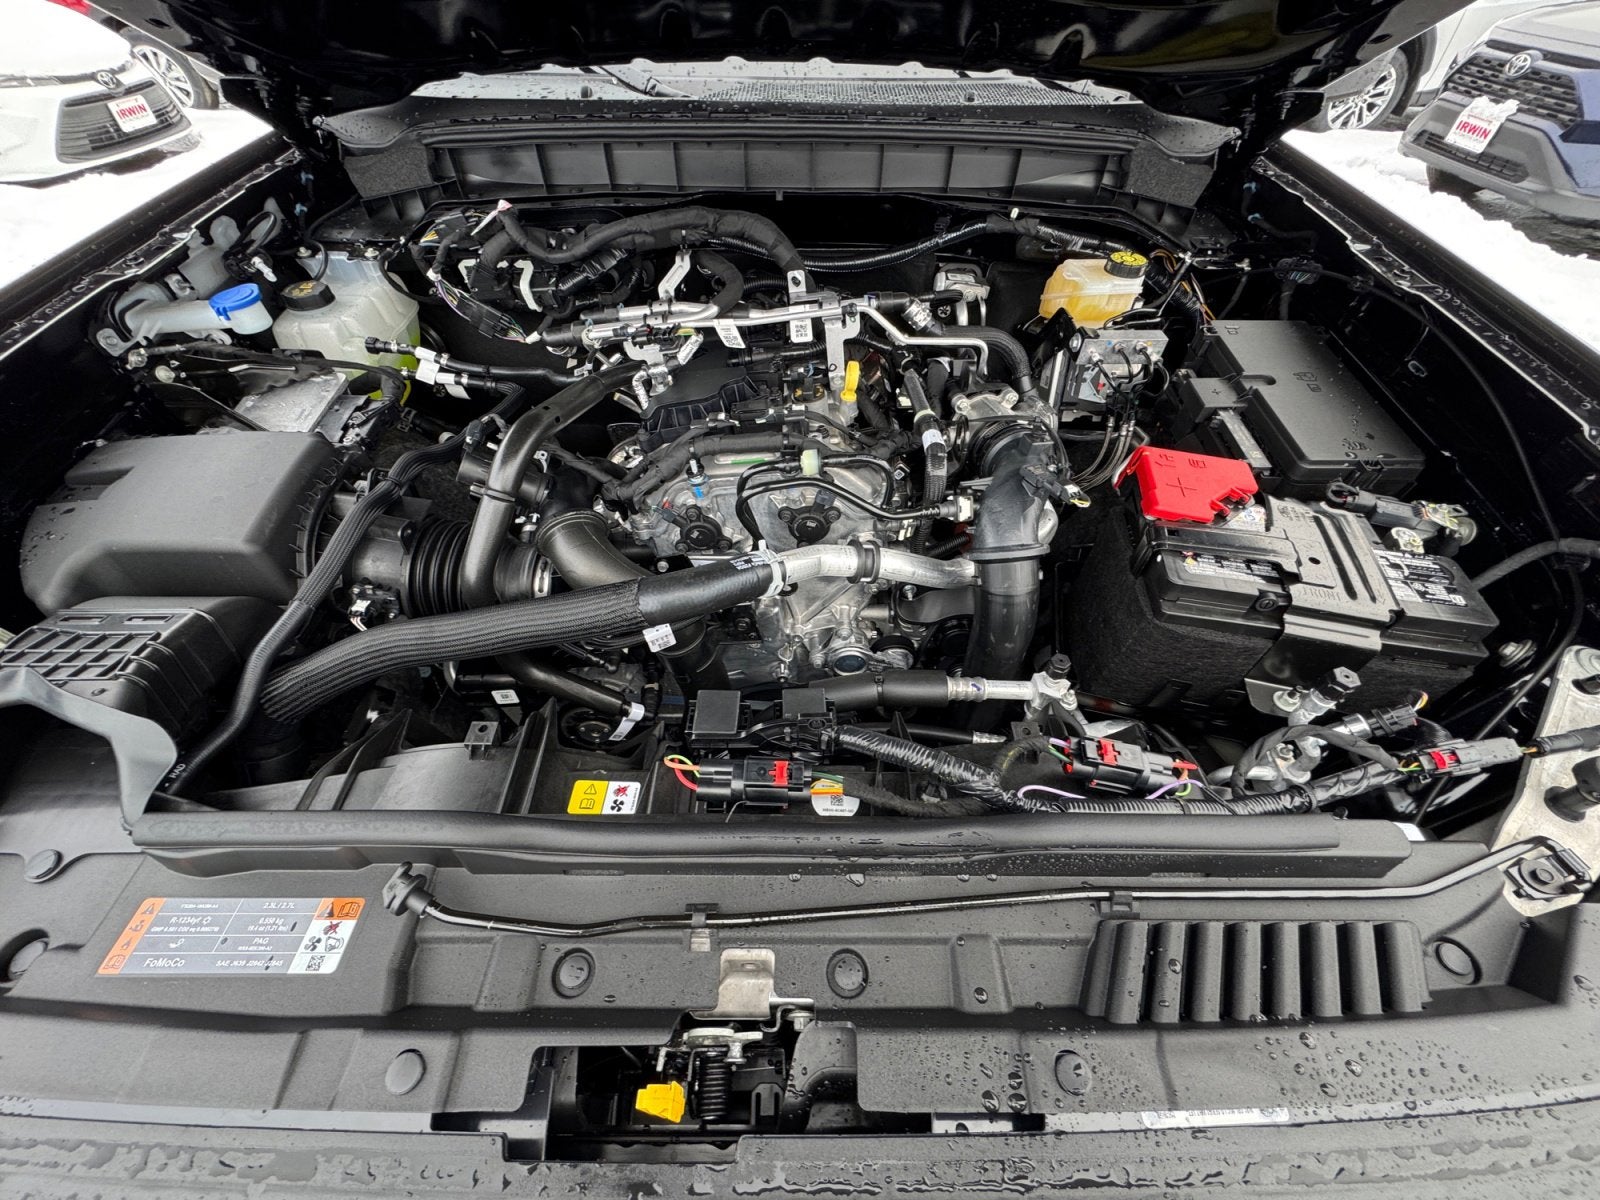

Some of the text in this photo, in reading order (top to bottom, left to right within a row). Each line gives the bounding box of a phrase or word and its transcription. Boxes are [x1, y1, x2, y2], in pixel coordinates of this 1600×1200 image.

[116, 103, 148, 120] IRWIN
[1455, 120, 1492, 140] IRWIN
[252, 937, 270, 945] PAG
[143, 957, 185, 968] FoMoCo
